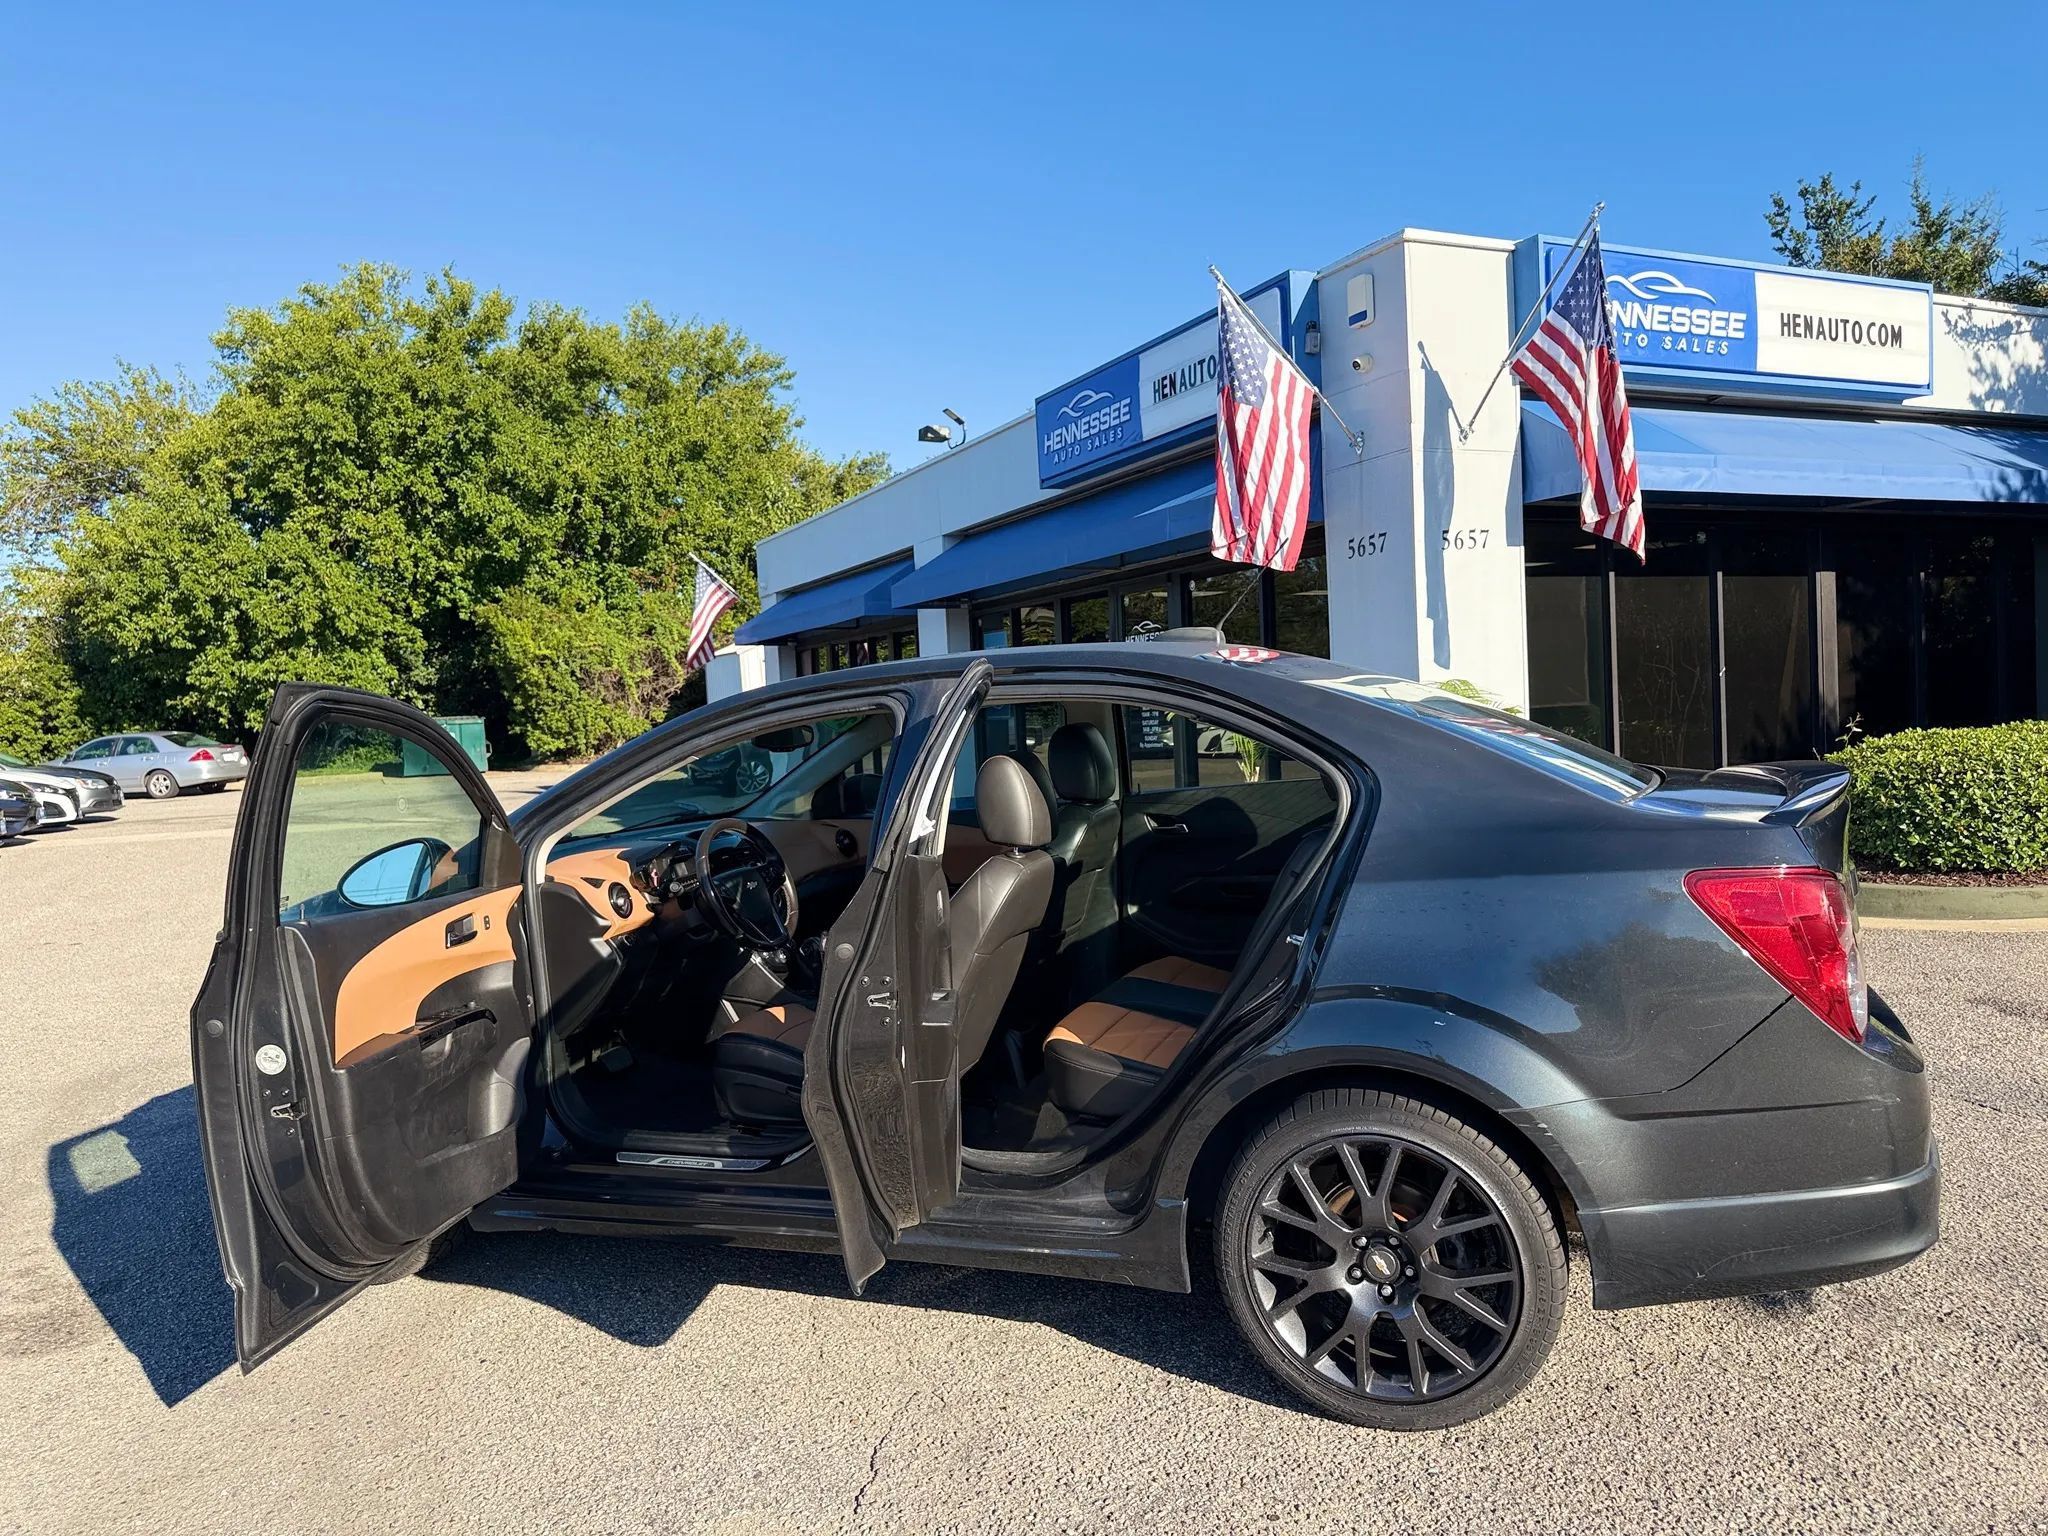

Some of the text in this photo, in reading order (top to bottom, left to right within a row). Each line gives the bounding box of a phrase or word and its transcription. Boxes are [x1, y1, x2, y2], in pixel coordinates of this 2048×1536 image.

[1611, 299, 1747, 339] NNESSEE
[1662, 335, 1729, 355] SALES
[1044, 397, 1132, 455] HENNESSEE
[1053, 427, 1123, 464] AUTO SALES
[1348, 532, 1388, 560] 5657
[1441, 528, 1490, 551] 5657
